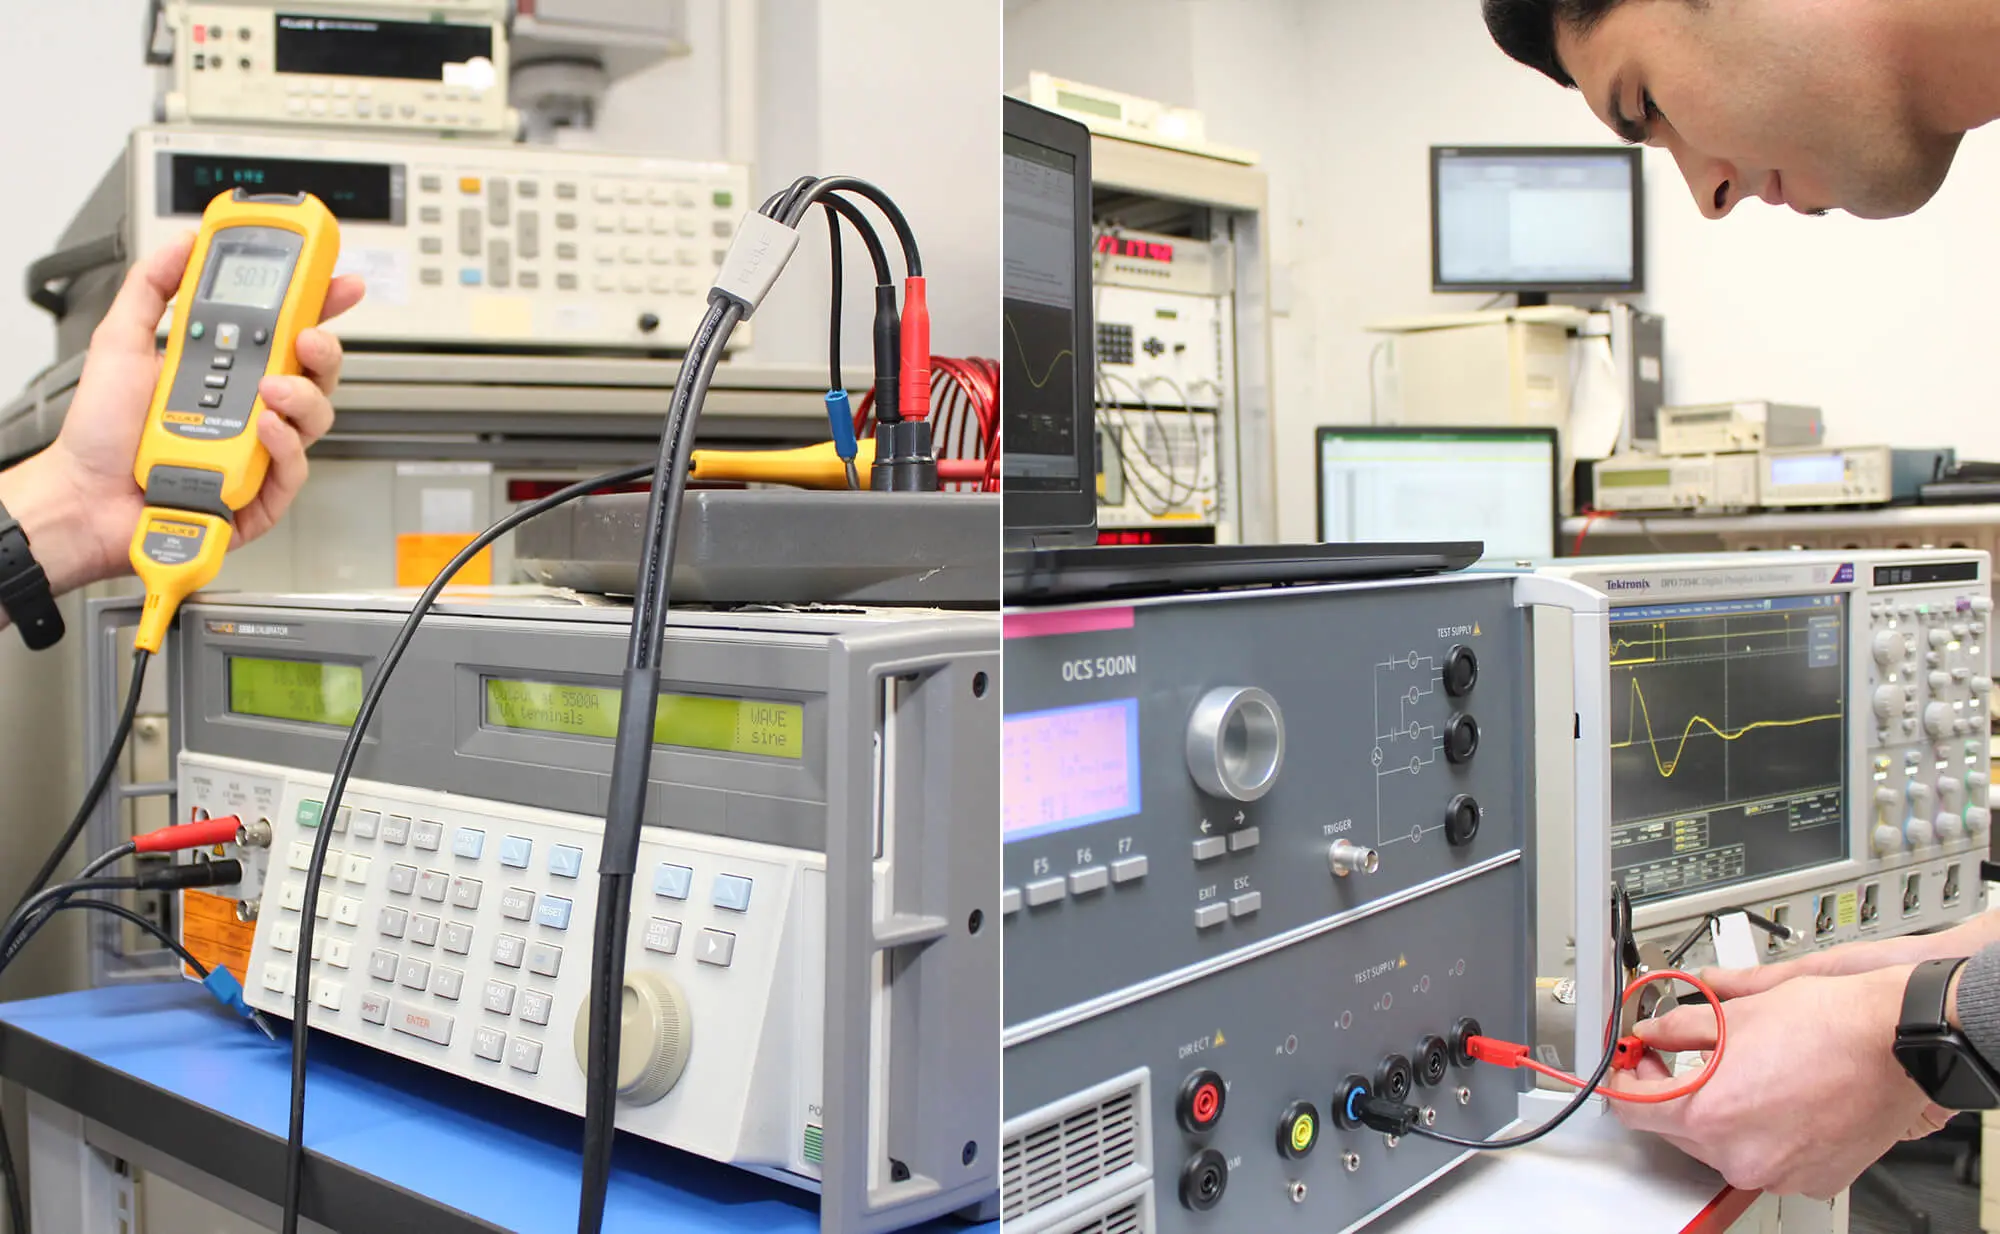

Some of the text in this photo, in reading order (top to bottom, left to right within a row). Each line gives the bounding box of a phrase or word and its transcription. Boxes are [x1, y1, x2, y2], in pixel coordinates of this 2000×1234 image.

[1606, 578, 1650, 590] Tektronix
[1438, 625, 1472, 638] TEST SUPPLY
[1062, 654, 1137, 682] OCS 500N
[562, 691, 599, 710] 5500A
[522, 706, 585, 725] terminals
[751, 707, 787, 728] WAVE
[751, 730, 787, 746] sine
[1323, 819, 1352, 836] TRIGGER
[1118, 837, 1133, 854] F7
[1077, 849, 1092, 865] F6
[1034, 857, 1049, 875] F5
[1233, 876, 1250, 890] ESC
[1199, 885, 1217, 900] EXIT
[539, 904, 563, 918] RESET
[646, 933, 671, 948] FIELD
[1355, 960, 1396, 984] TEST SUPPLY
[406, 1014, 430, 1028] ENTER
[1179, 1036, 1210, 1059] DIRECT
